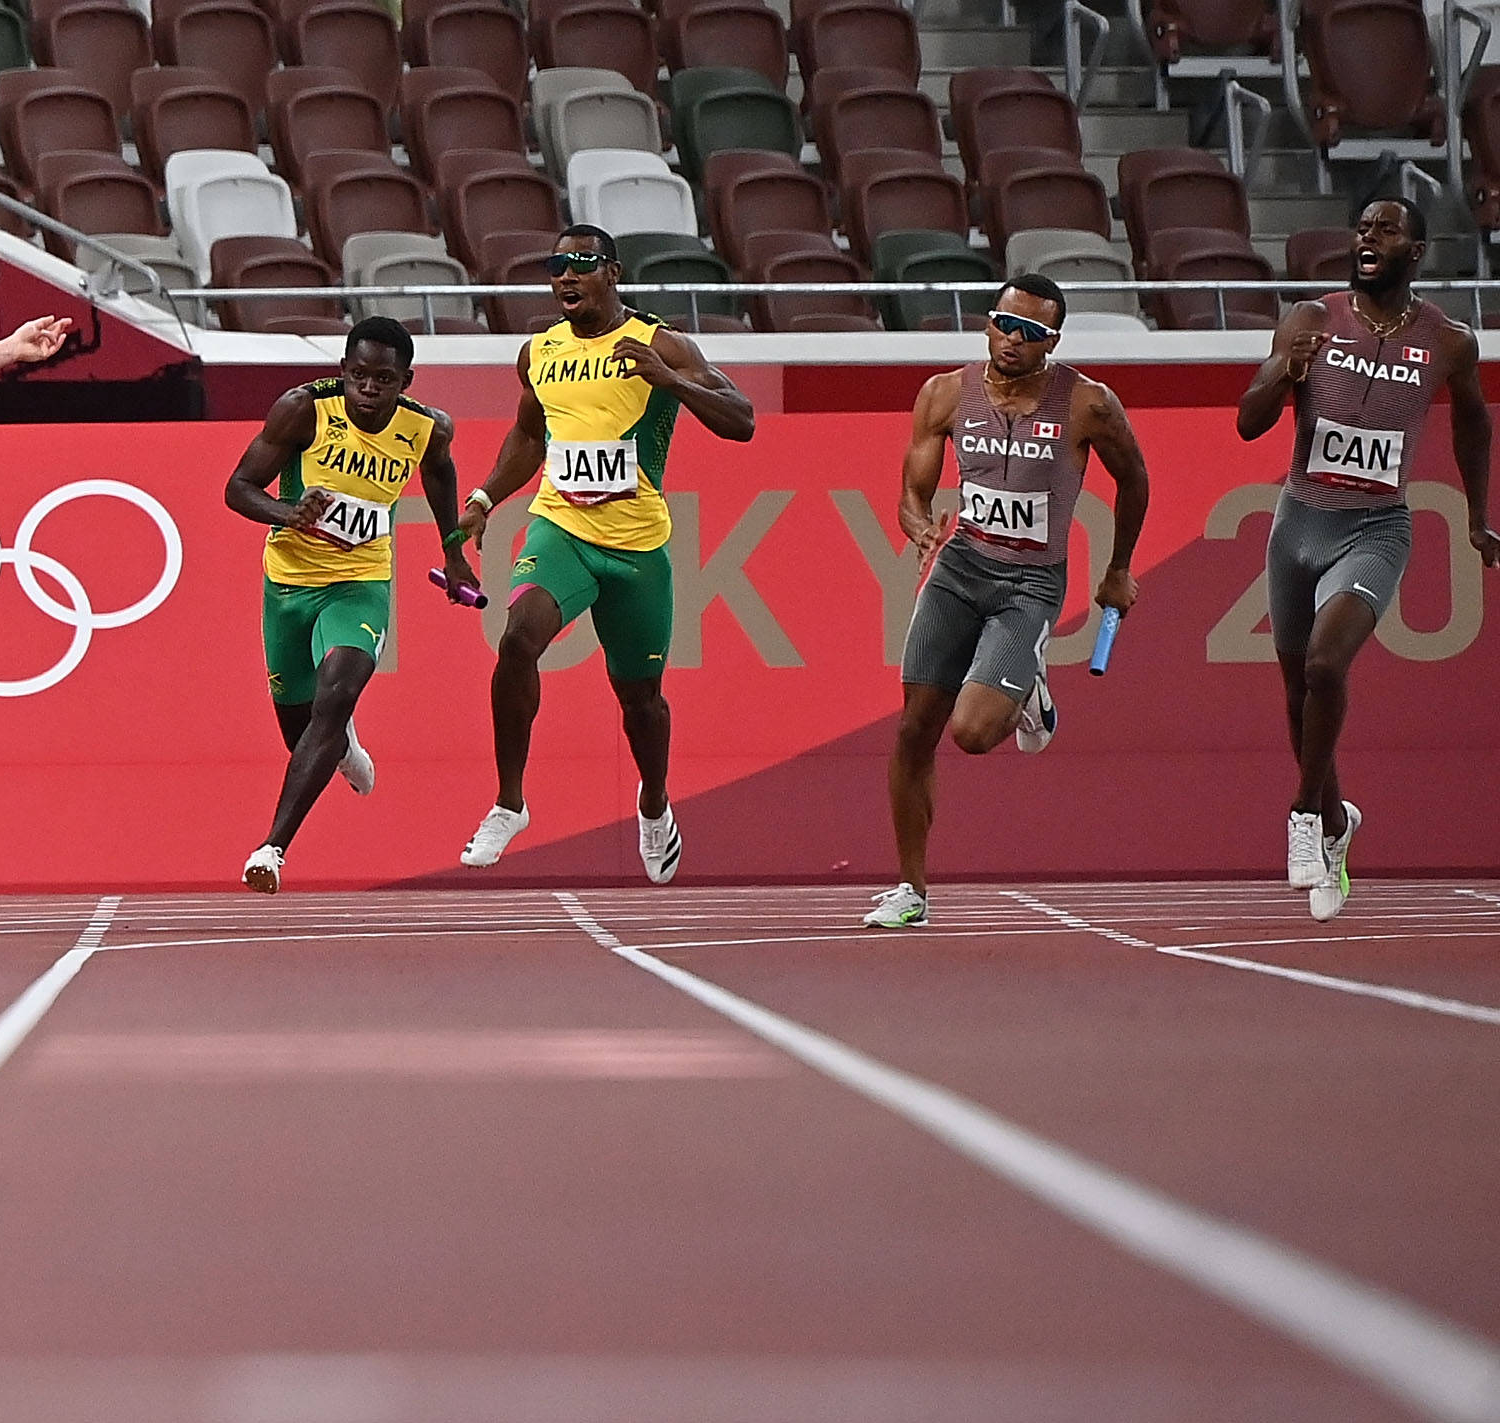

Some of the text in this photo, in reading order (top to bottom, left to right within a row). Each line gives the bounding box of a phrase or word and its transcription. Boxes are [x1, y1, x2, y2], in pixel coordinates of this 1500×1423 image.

[537, 356, 629, 386] JAMAICA
[1326, 349, 1421, 386] CANADA
[317, 445, 411, 483] JAMAICA
[559, 449, 626, 482] JAM
[962, 435, 1054, 460] CANADA
[1322, 430, 1391, 471] CAN
[324, 501, 378, 540] AM
[972, 493, 1033, 530] CAN
